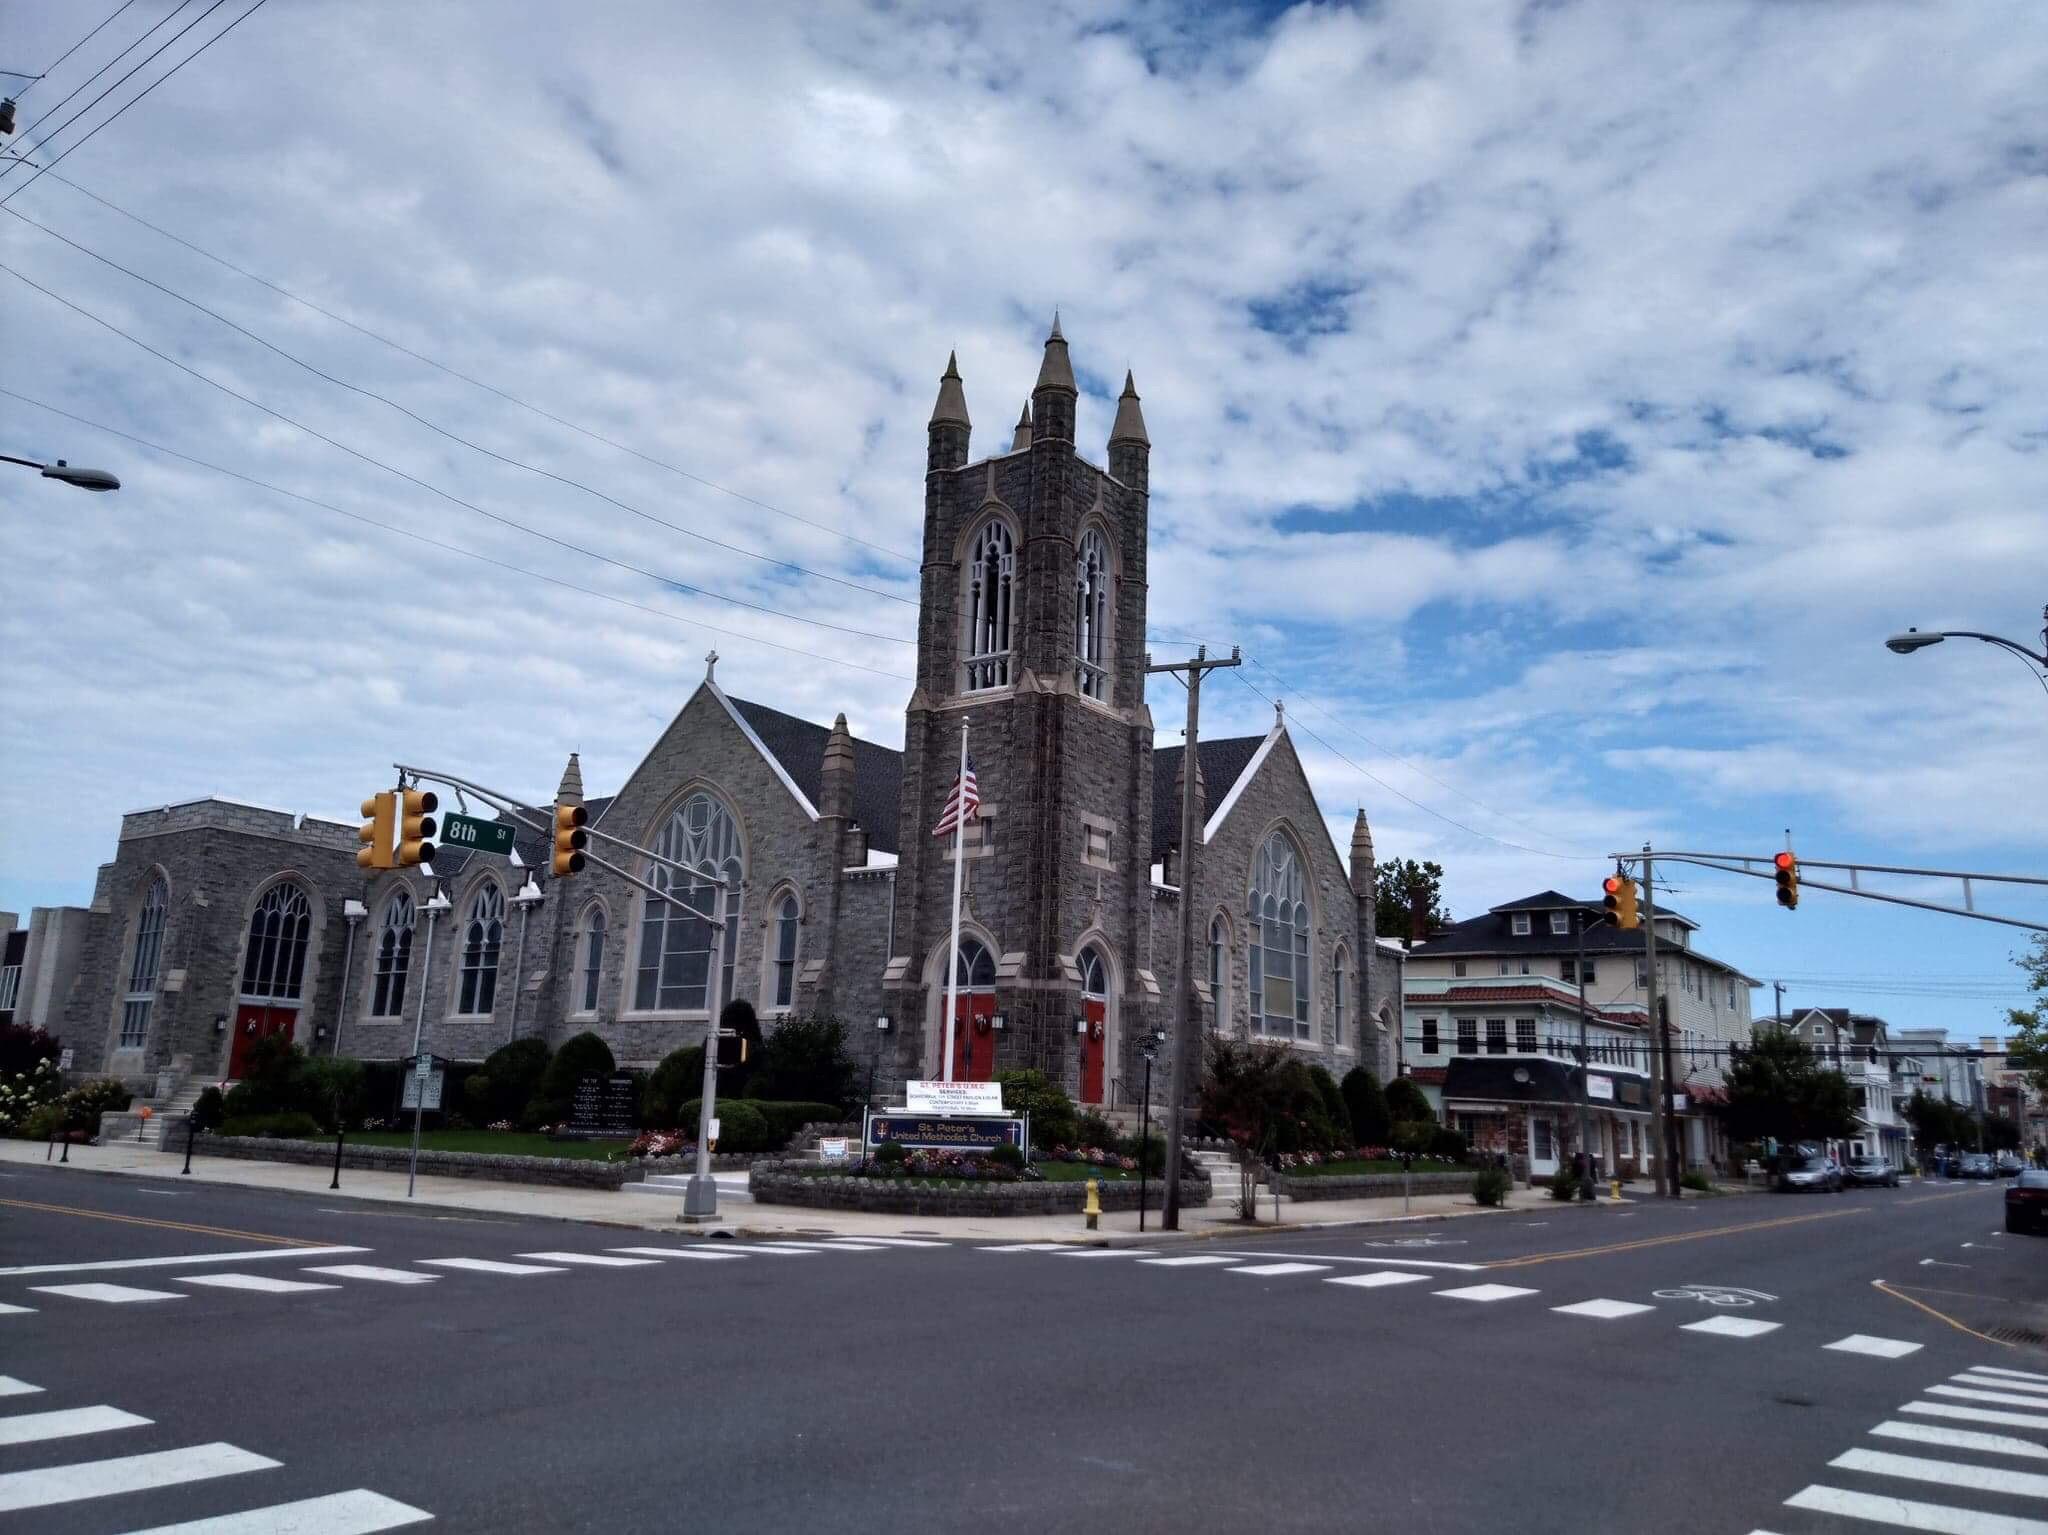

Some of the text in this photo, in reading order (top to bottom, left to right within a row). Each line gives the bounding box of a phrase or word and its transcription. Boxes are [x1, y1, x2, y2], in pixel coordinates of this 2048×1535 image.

[449, 821, 506, 842] 8th St
[918, 1122, 976, 1133] St. Peter's
[890, 1130, 1002, 1144] United Methodist Church
